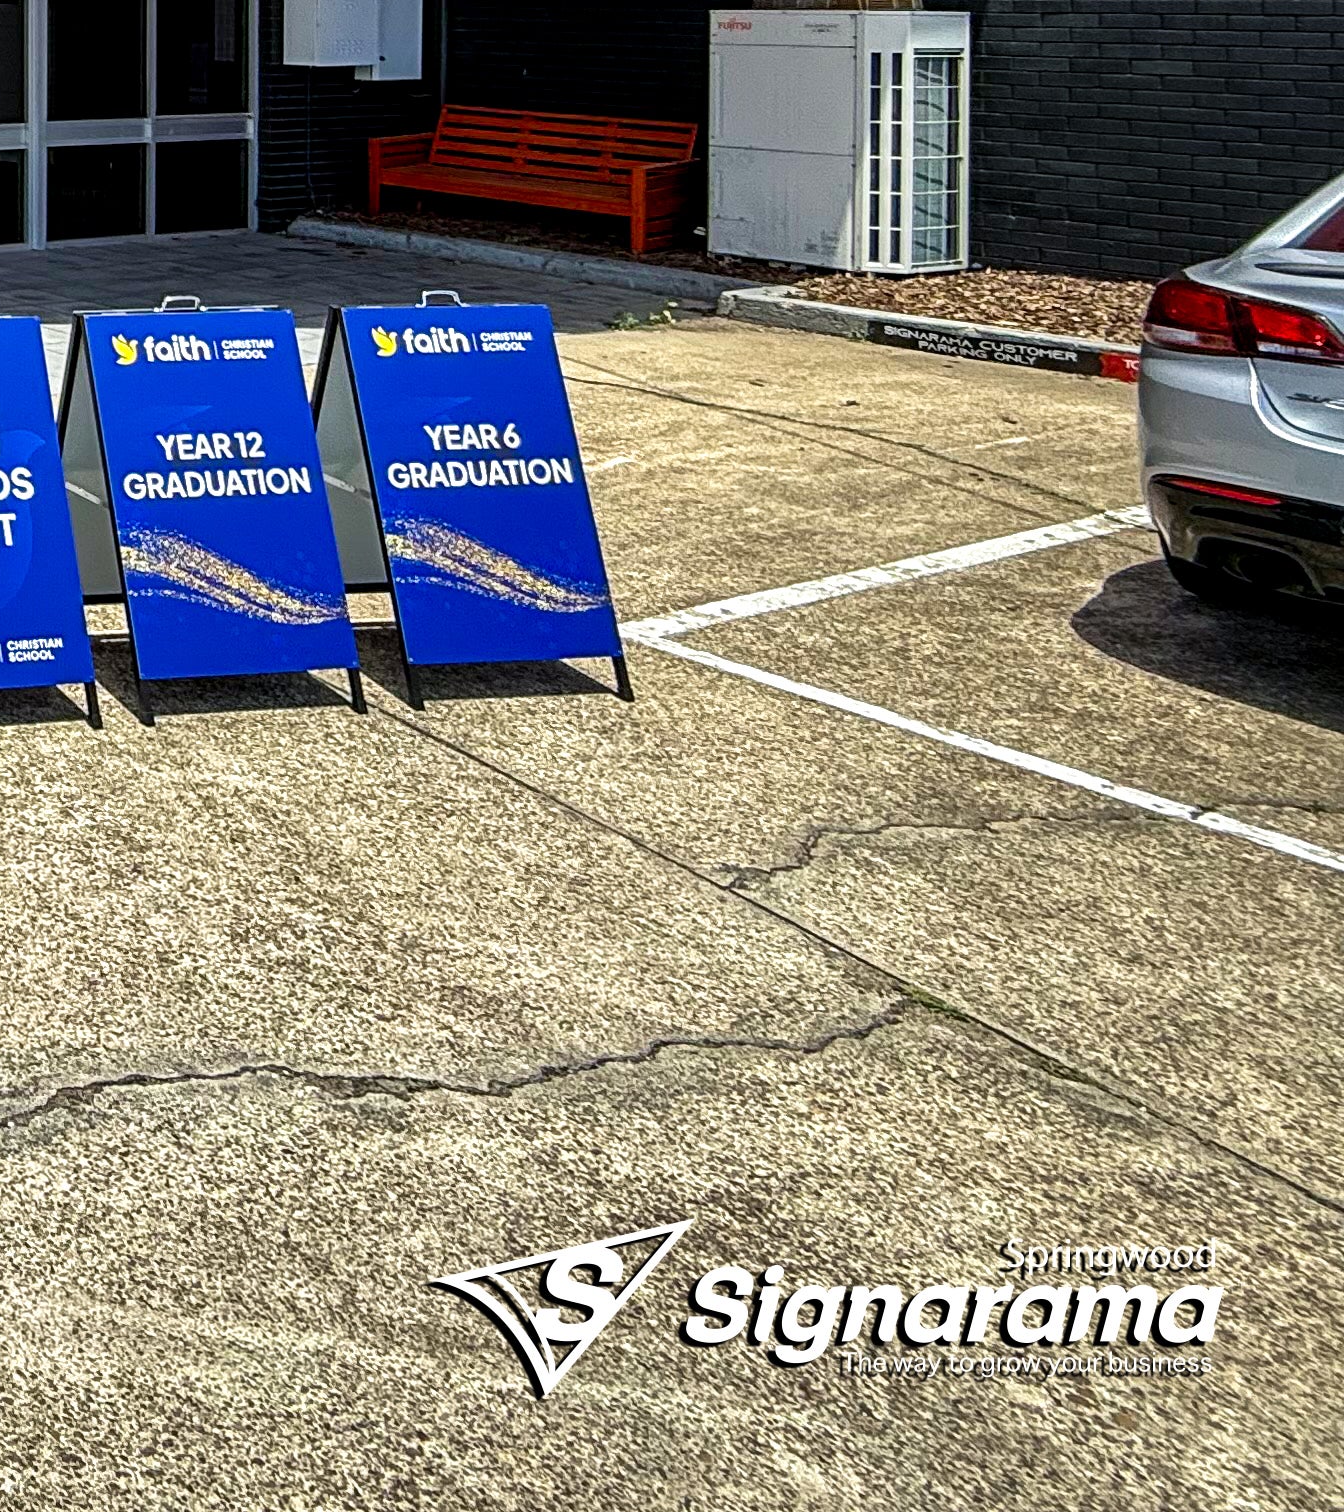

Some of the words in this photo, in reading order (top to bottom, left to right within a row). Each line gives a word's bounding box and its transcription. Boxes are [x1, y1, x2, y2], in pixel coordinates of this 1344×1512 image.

[718, 18, 752, 31] FUJITSU
[144, 335, 211, 362] faith
[221, 339, 274, 349] CHRISTIAN
[403, 327, 470, 353] faith
[480, 332, 532, 342] CHRISTIAN
[482, 342, 525, 351] SCHOOL
[883, 326, 973, 349] SIGNARAMA
[980, 340, 1078, 362] CUSTOMER
[223, 350, 266, 360] SCHOOL
[918, 341, 987, 360] PARKING
[994, 352, 1037, 366] ONLY
[156, 433, 234, 460] YEAR
[234, 432, 266, 458] 12
[424, 424, 501, 450] YEAR
[503, 423, 521, 448] 6
[124, 467, 311, 499] GRADUATION
[388, 458, 573, 488] GRADUATION
[7, 638, 63, 651] CHRISTIAN
[9, 650, 54, 662] SCHOOL
